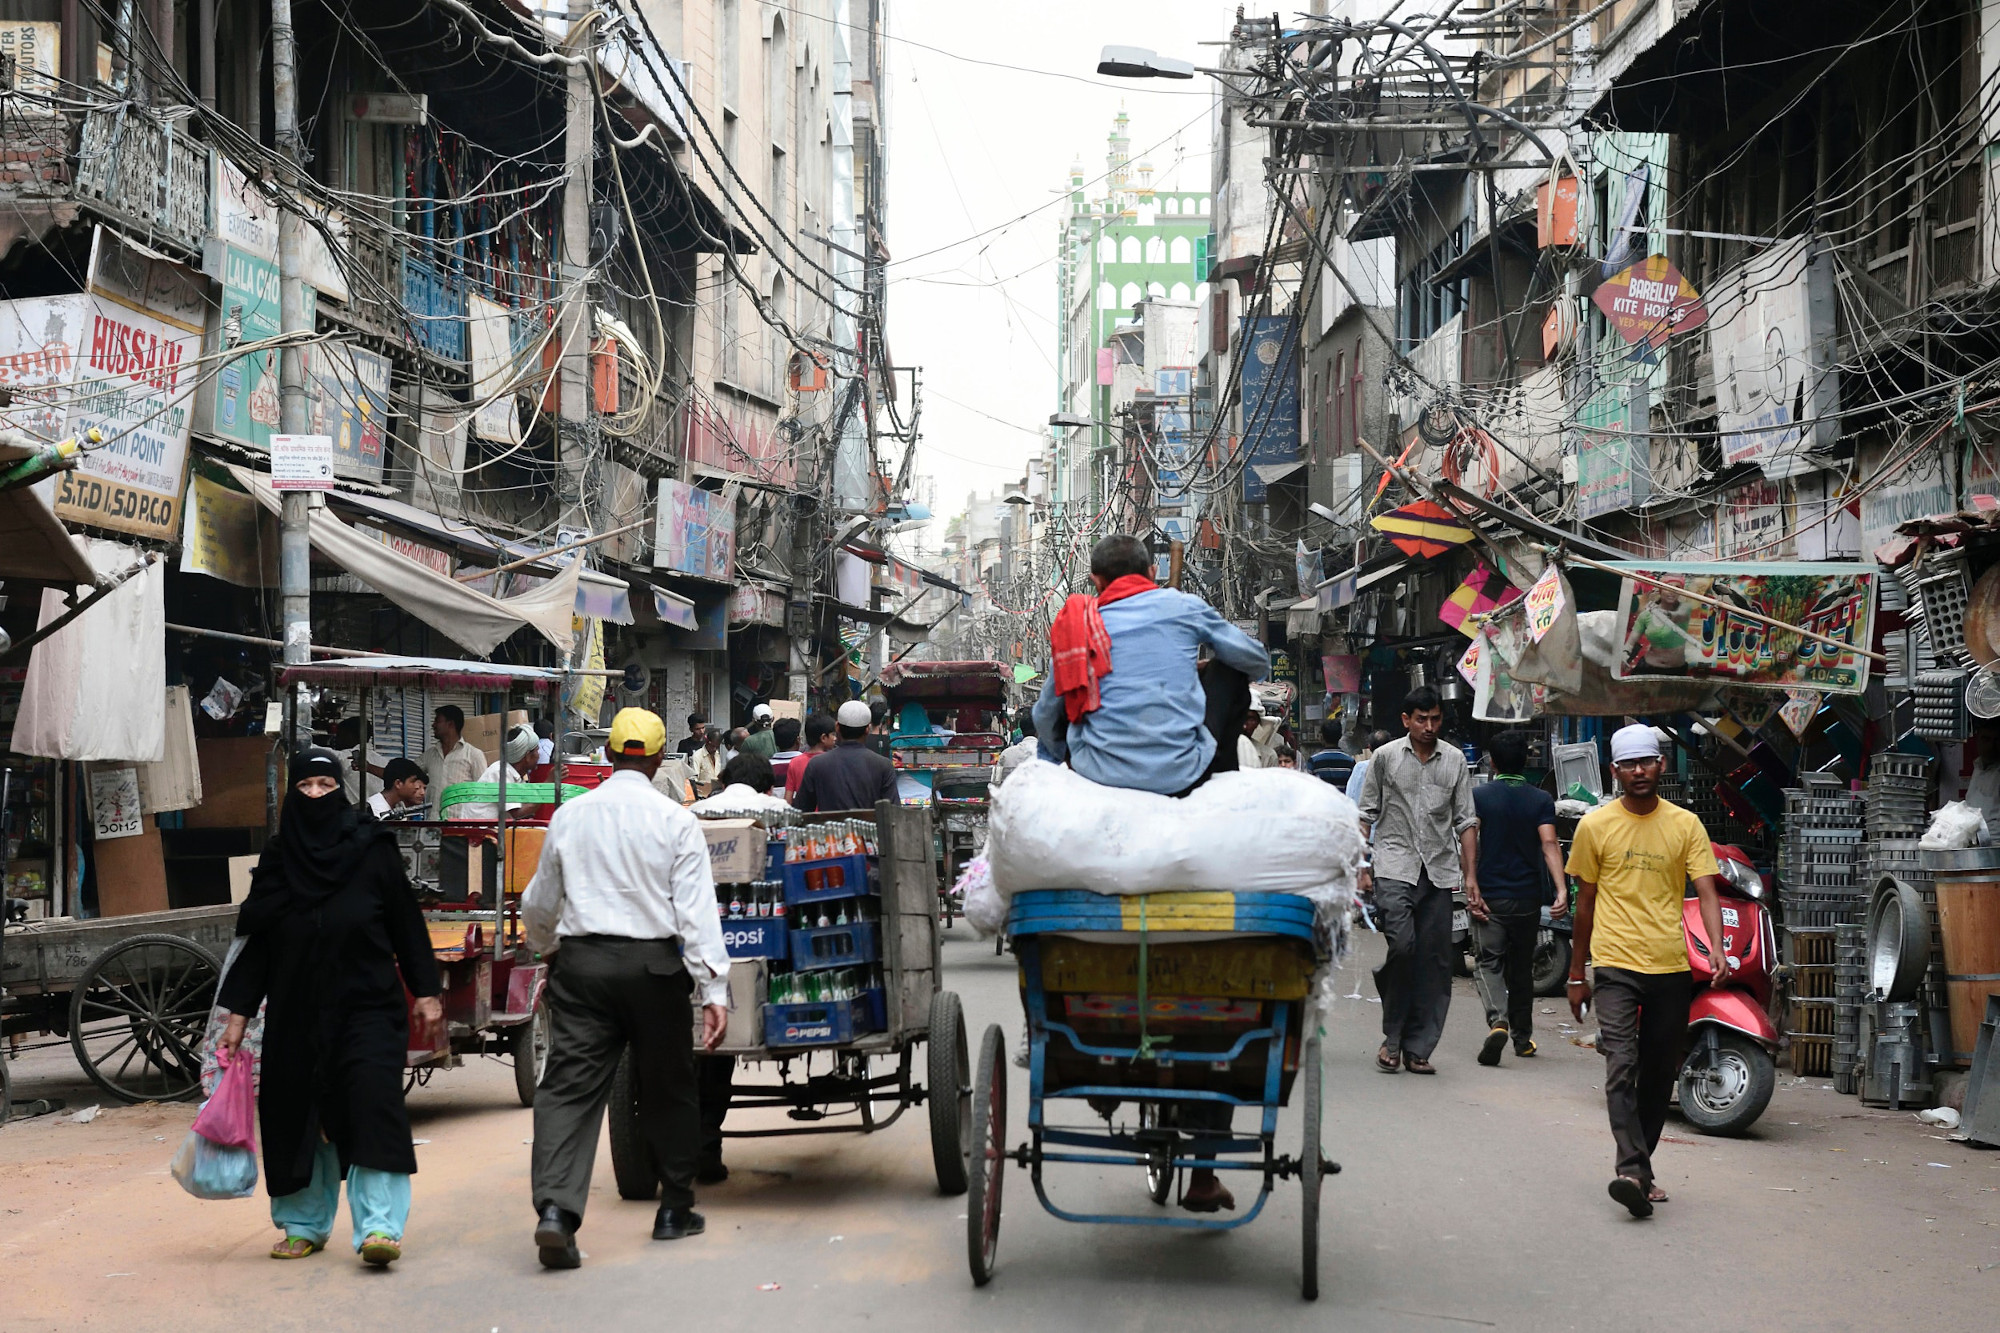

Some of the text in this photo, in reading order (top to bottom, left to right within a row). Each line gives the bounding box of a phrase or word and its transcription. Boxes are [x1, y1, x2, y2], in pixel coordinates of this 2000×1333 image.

[227, 254, 254, 294] LALA
[1628, 277, 1679, 304] BAREILLY
[1613, 297, 1686, 322] KITE HOUSE
[1618, 316, 1635, 328] VED
[90, 315, 183, 394] HUSSAIN
[357, 359, 387, 394] WALE
[78, 375, 129, 421] STATIONERY
[130, 432, 166, 466] POINT
[57, 476, 103, 510] S.T.D
[102, 485, 138, 519] I.S.D
[138, 494, 172, 527] P.C.O
[1864, 494, 1900, 532] ELECTRONIC
[1810, 668, 1834, 681] 10/-
[99, 820, 138, 834] DOMS
[723, 928, 765, 948] epsi
[65, 955, 88, 967] 786
[799, 1027, 831, 1039] PEPSI
